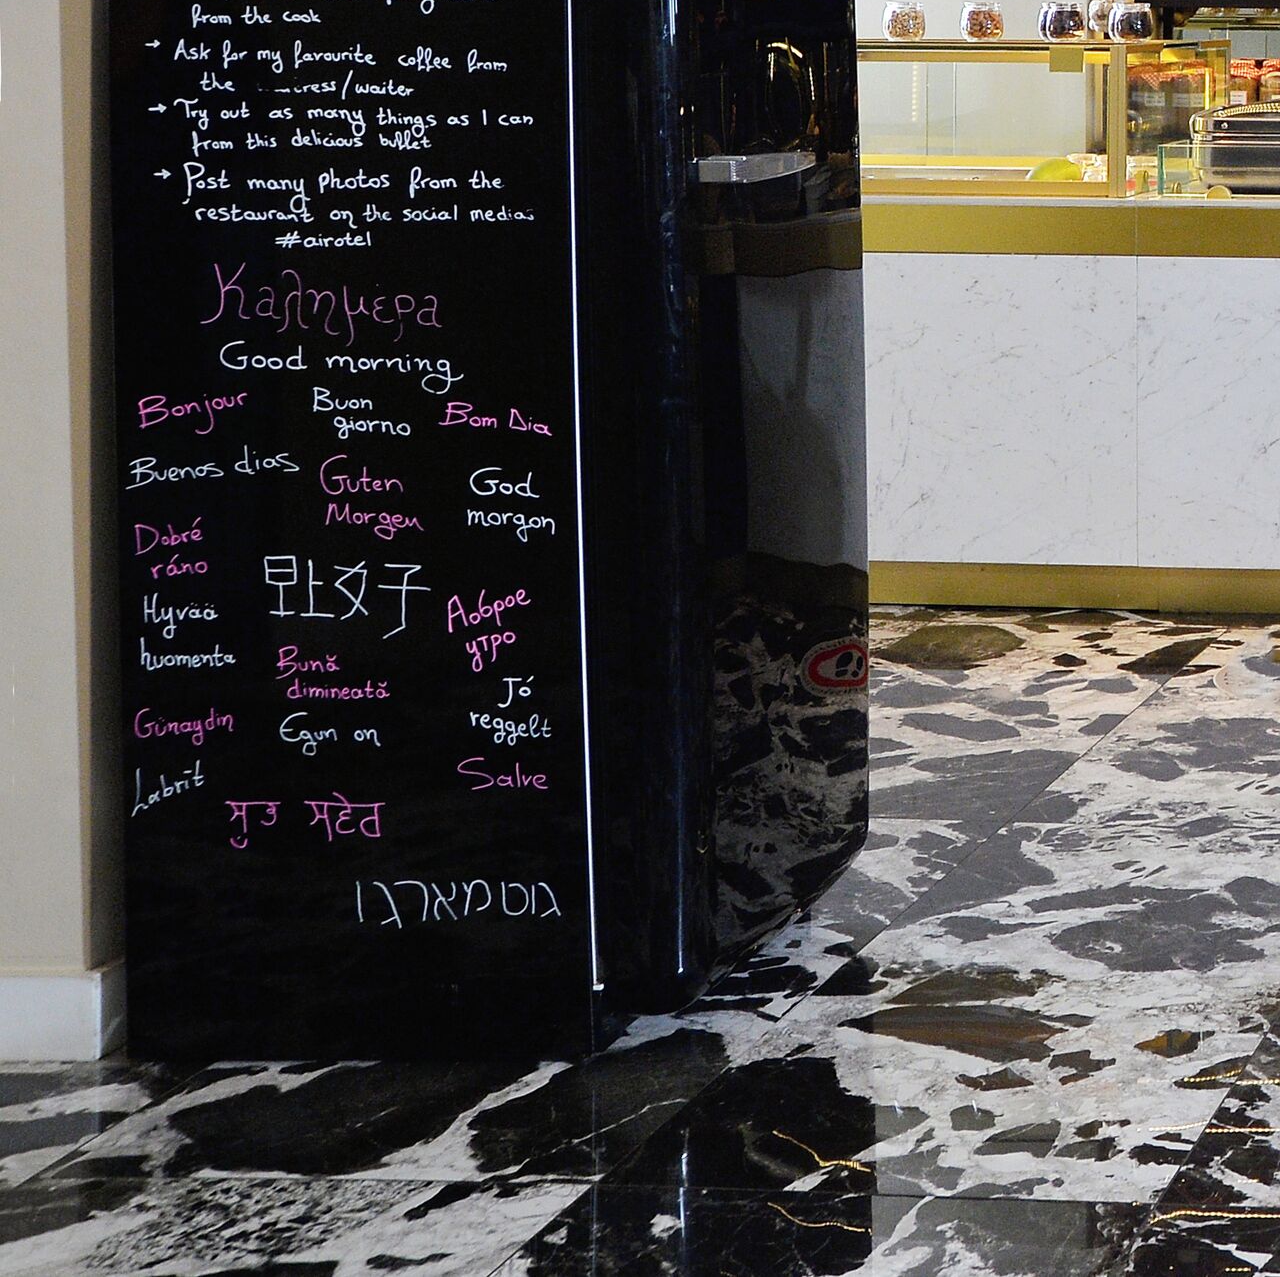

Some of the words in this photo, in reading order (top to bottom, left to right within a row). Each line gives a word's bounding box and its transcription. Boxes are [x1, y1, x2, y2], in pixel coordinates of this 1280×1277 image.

[192, 4, 232, 28] from
[241, 5, 272, 24] the
[283, 9, 321, 23] cook
[174, 38, 212, 60] Ask
[223, 40, 248, 69] for
[257, 50, 284, 73] my
[294, 40, 376, 69] favourite
[398, 46, 451, 72] coffee
[467, 49, 507, 73] from
[200, 71, 235, 91] the
[173, 98, 209, 130] Try
[220, 101, 250, 119] out
[268, 107, 293, 119] as
[307, 108, 366, 136] many
[376, 107, 437, 137] things
[446, 114, 469, 125] as
[482, 109, 487, 126] I
[498, 114, 533, 125] can
[192, 130, 233, 157] from
[246, 132, 277, 150] this
[291, 127, 363, 148] delicious
[379, 129, 432, 150] buffet
[182, 161, 231, 205] Post
[247, 177, 311, 213] many
[318, 167, 390, 194] photos
[409, 166, 457, 199] from
[468, 169, 505, 189] the
[195, 204, 314, 223] restaurant
[330, 210, 358, 228] on
[362, 204, 392, 222] the
[402, 204, 458, 222] social
[275, 231, 371, 248] #airotel
[220, 341, 307, 370] Good
[326, 354, 464, 395] morning
[138, 393, 248, 435] Bonjour
[312, 386, 372, 411] Buon
[333, 416, 411, 439] giorno
[438, 402, 497, 429] Bom
[509, 408, 552, 436] Dia
[125, 457, 224, 490] Buenos
[234, 444, 300, 475] dias
[320, 455, 403, 495] Guten
[469, 467, 540, 498] God
[134, 517, 204, 555] Dobré
[326, 502, 424, 540] Morgen
[467, 509, 555, 542] morgon
[150, 554, 208, 579] ráno
[144, 593, 218, 639] Hyvää
[140, 637, 237, 671] huomenta
[276, 645, 340, 679] Bună
[466, 631, 516, 672] утро
[497, 675, 535, 708] Jó
[279, 712, 337, 756] Egun
[354, 729, 381, 747] on
[470, 711, 552, 746] reggelt
[457, 757, 549, 790] Salve
